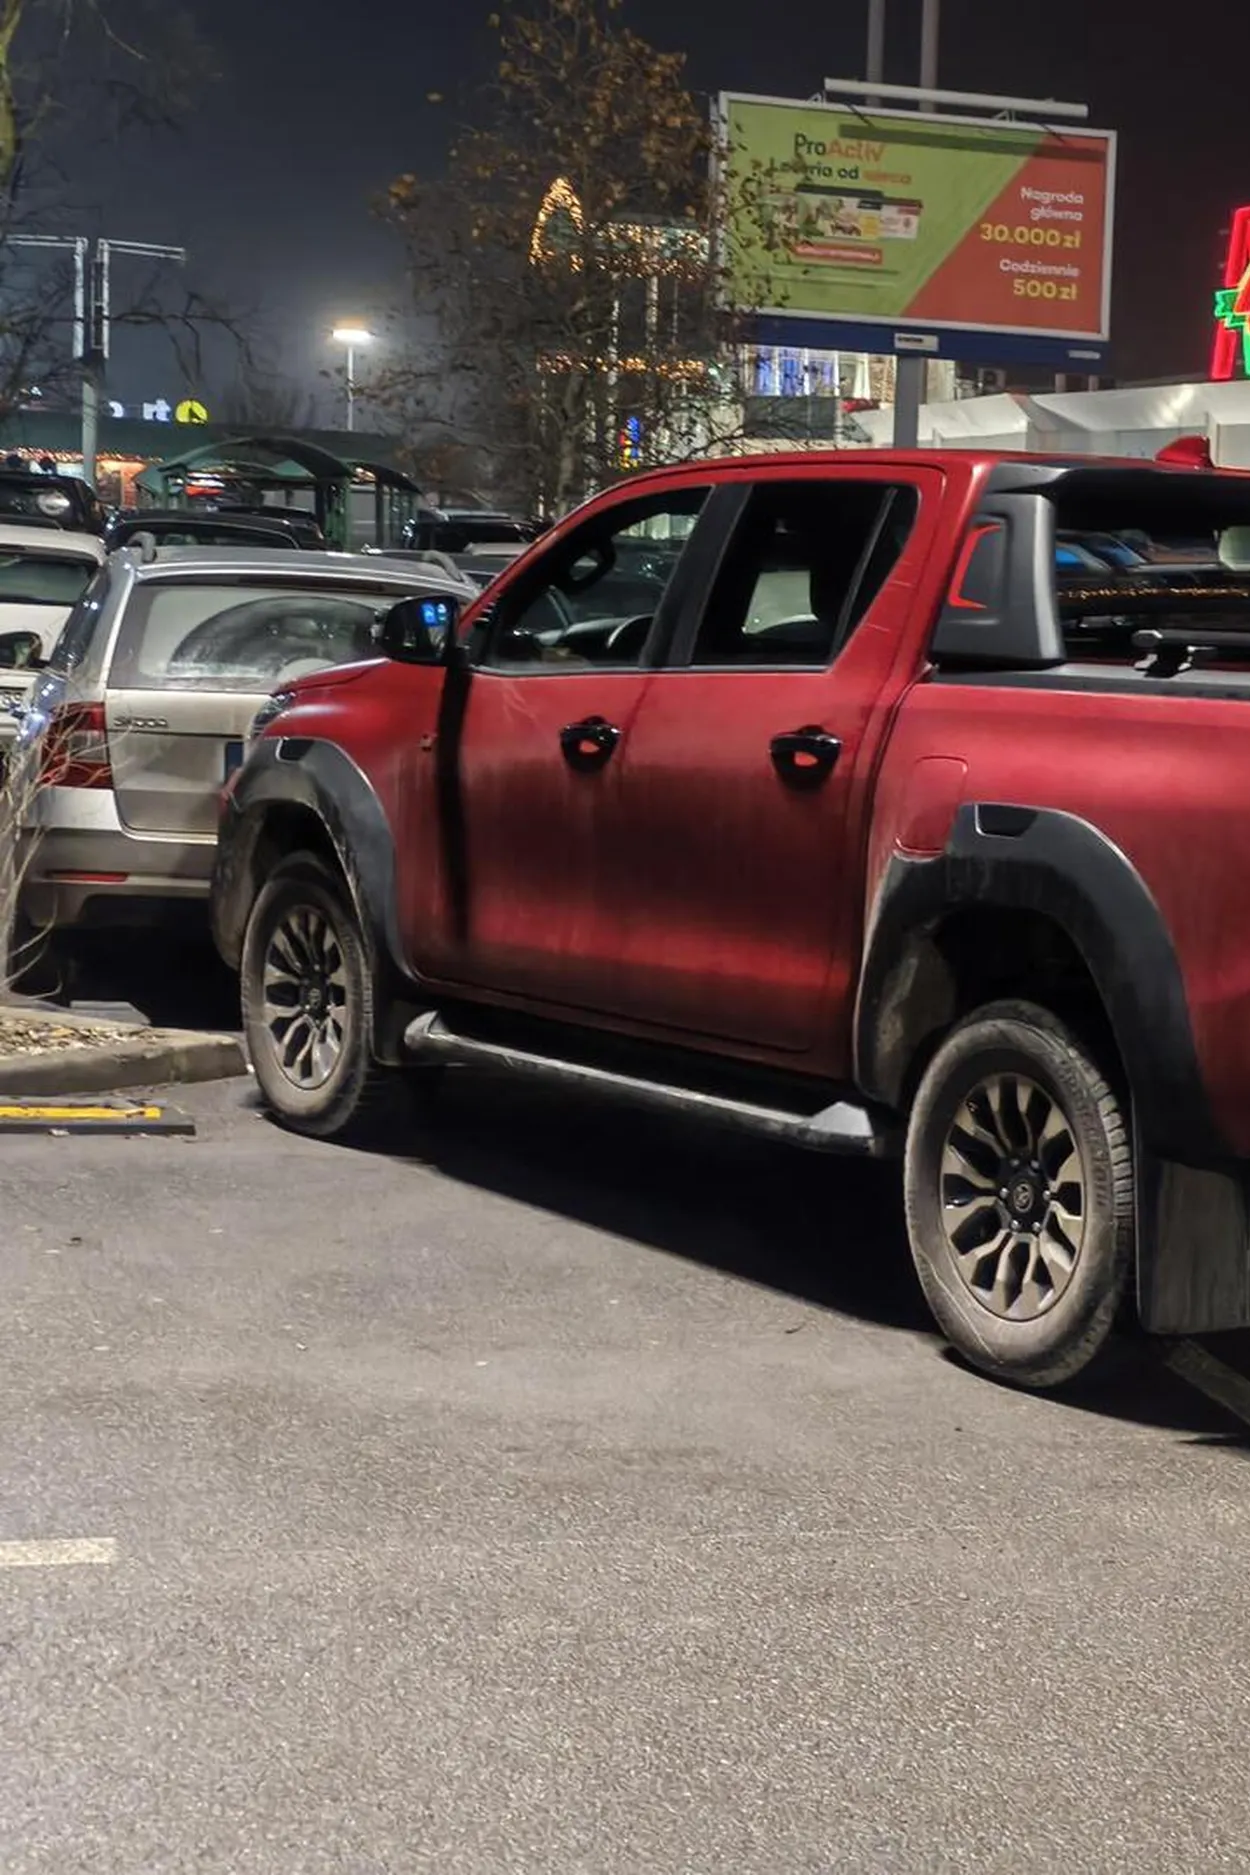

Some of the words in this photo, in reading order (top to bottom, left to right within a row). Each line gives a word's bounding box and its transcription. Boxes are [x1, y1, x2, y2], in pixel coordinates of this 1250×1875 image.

[837, 165, 860, 180] od
[1020, 186, 1084, 205] Nagroda
[999, 258, 1080, 277] Codziennie
